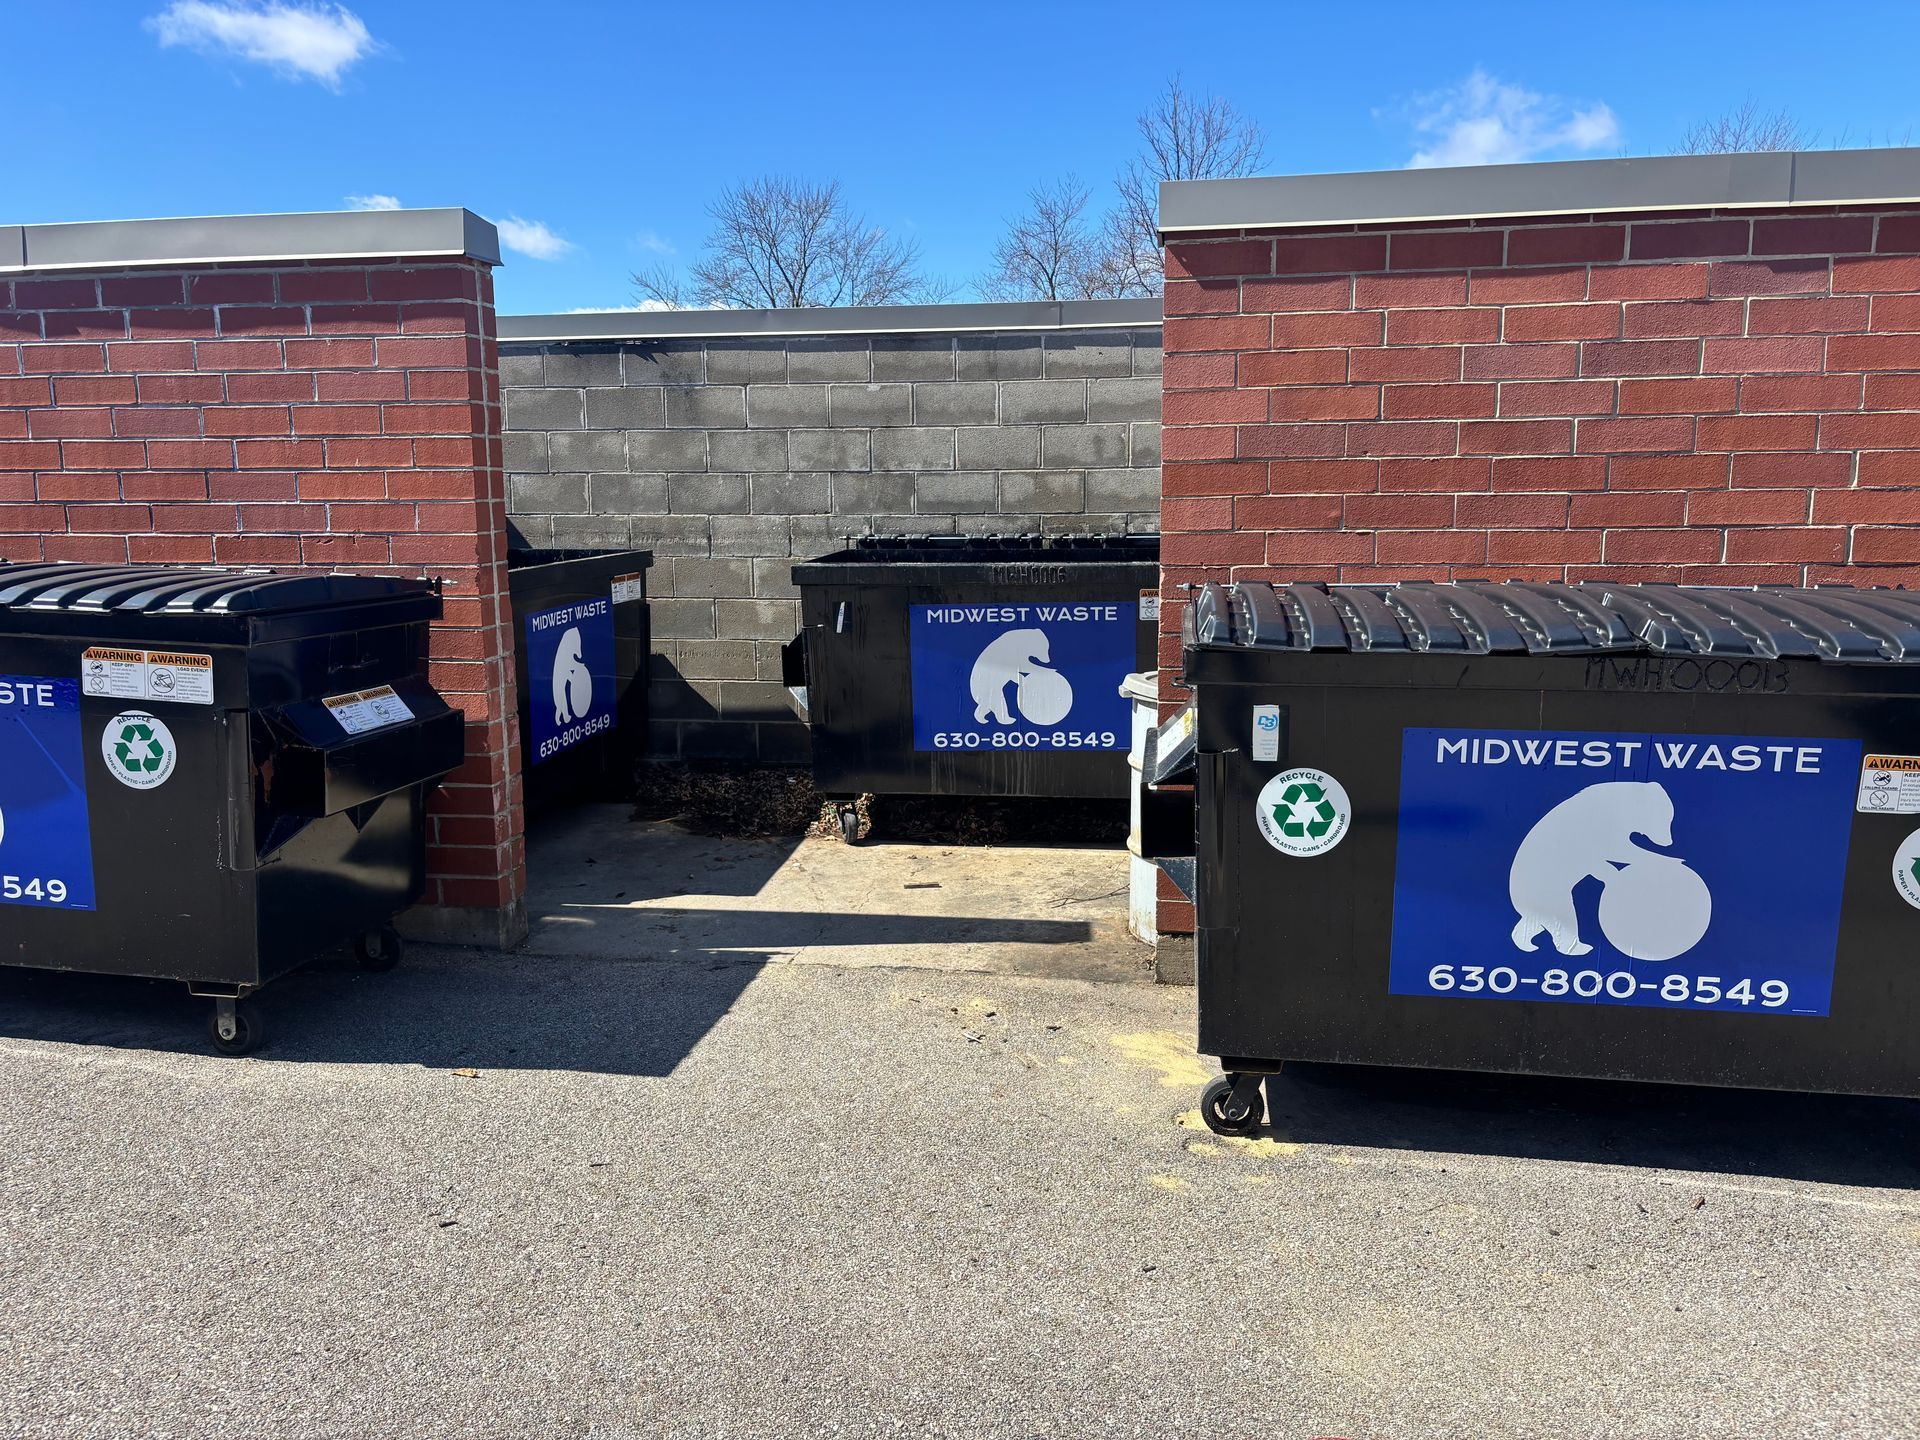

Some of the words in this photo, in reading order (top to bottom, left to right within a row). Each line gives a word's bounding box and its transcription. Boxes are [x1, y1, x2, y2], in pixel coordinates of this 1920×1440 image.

[532, 608, 573, 632] MIDWEST
[575, 600, 607, 620] WASTE
[927, 607, 1030, 624] MIDWEST
[1036, 606, 1118, 622] WASTE
[93, 650, 142, 662] WARNING
[157, 654, 208, 666] WARNING
[540, 713, 610, 758] 630-800-8549
[933, 731, 1116, 748] 630-800-8549
[118, 771, 139, 785] PLASTIC
[157, 750, 173, 779] CARDBOARD
[1436, 737, 1642, 768] MIDWEST
[1654, 743, 1823, 774] WASTE
[1279, 772, 1325, 785] RECYCLE
[1262, 816, 1272, 836] PAPER
[1273, 837, 1298, 852] PLASTIC
[1323, 813, 1346, 846] CARDBOARD
[3, 875, 67, 902] 549
[1898, 869, 1908, 890] PAPER
[1908, 891, 1920, 904] PLA
[1428, 964, 1790, 1008] 630-800-8549
